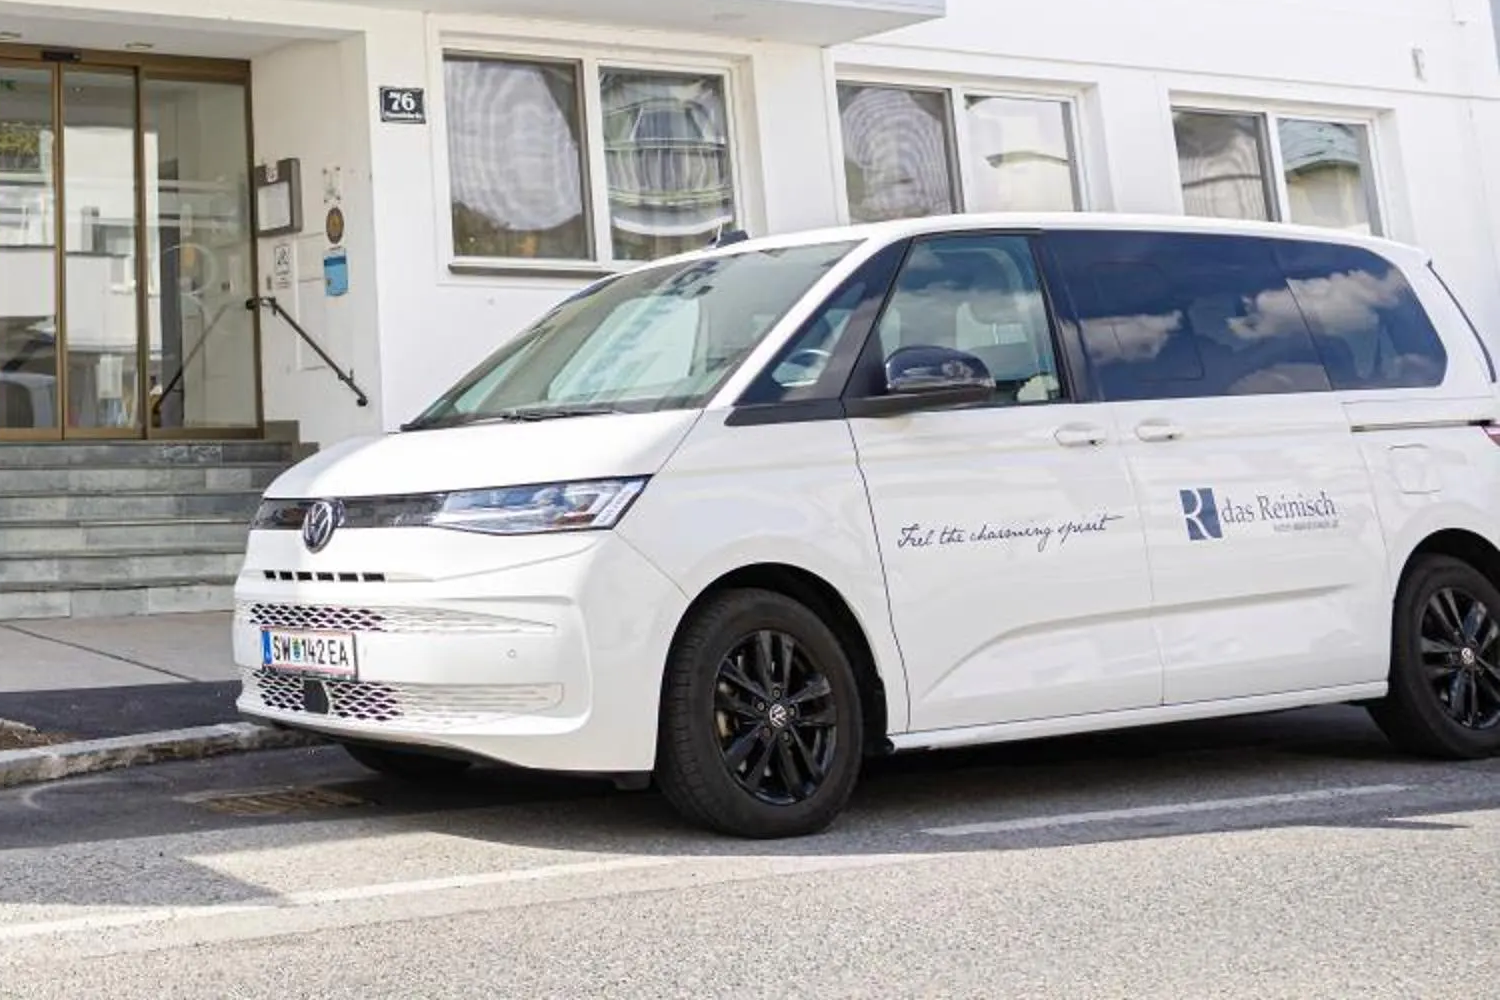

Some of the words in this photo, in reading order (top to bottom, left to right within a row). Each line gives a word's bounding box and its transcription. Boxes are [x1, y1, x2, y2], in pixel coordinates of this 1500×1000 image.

[388, 91, 415, 111] 76
[1221, 497, 1255, 524] das
[1256, 490, 1337, 521] Reinisch
[938, 526, 966, 545] the
